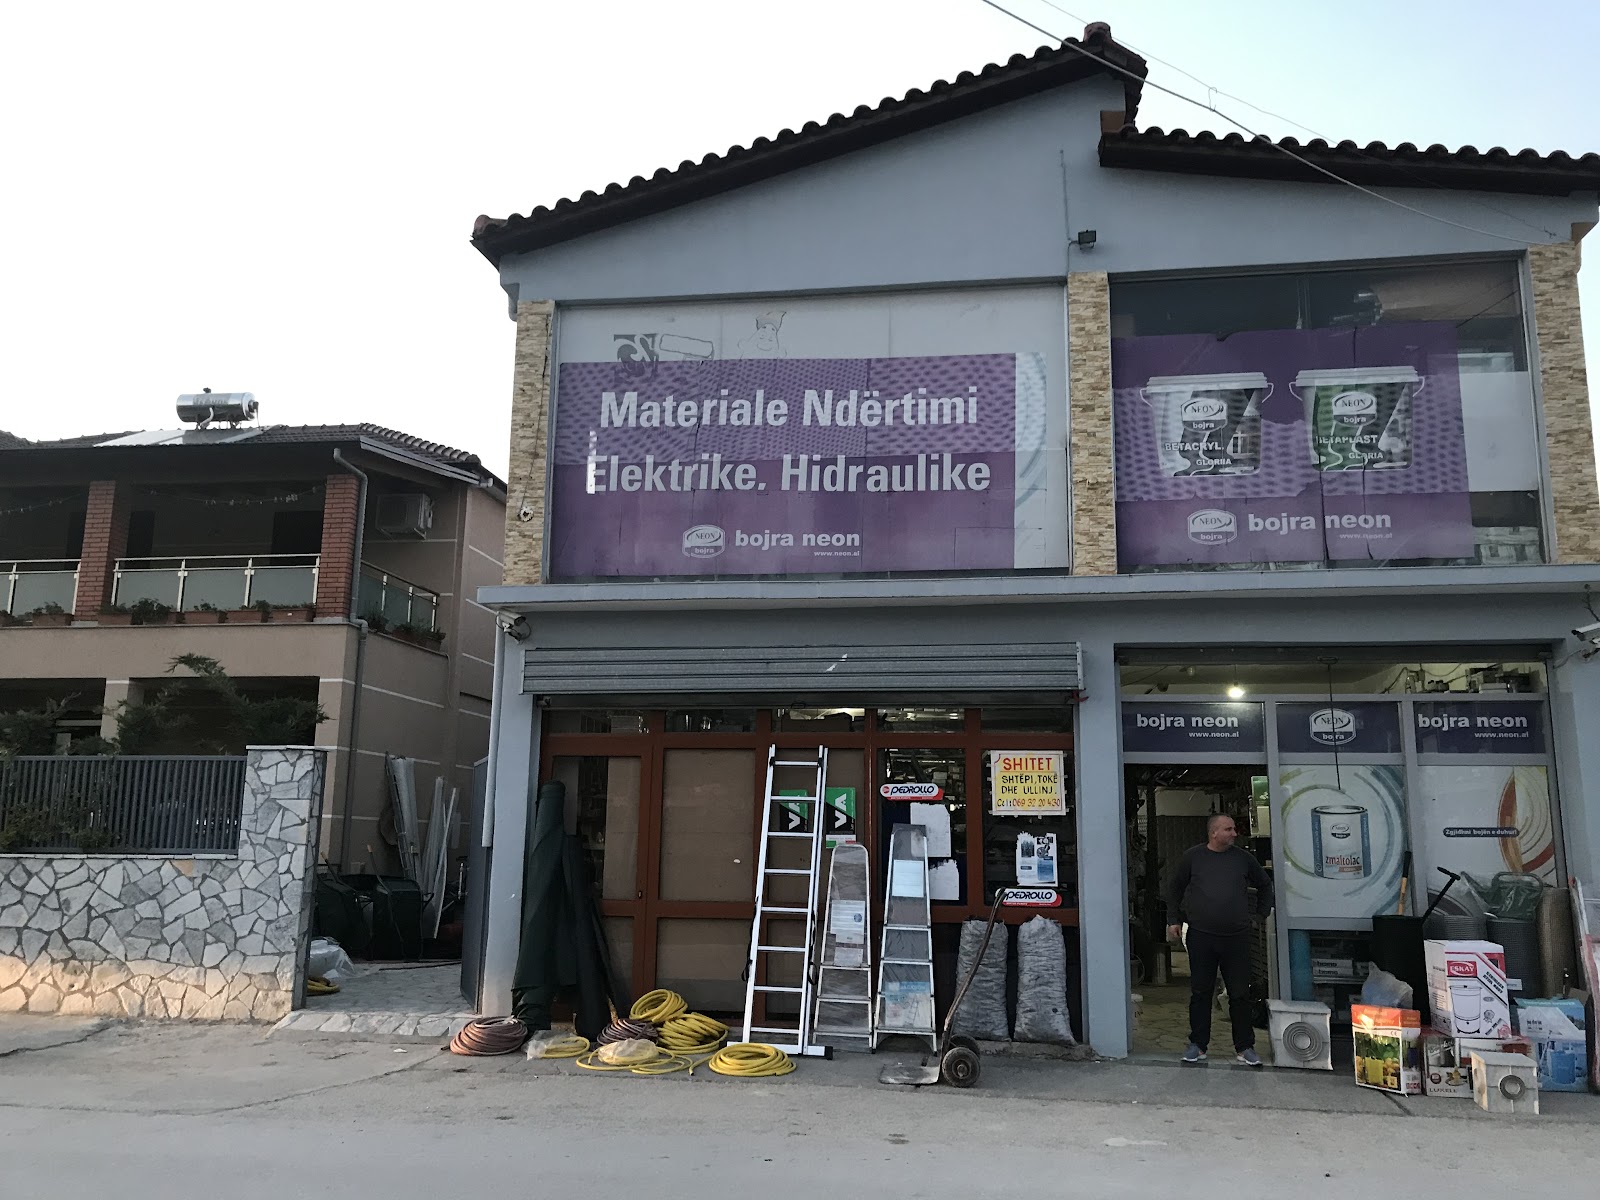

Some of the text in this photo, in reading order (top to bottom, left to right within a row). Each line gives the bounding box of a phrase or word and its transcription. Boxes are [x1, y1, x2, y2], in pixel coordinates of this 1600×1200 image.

[600, 386, 978, 428] Materiale Ndërtimi
[1341, 399, 1366, 407] NEON
[1191, 405, 1214, 413] NEON
[1343, 416, 1366, 424] bojra
[1192, 422, 1215, 430] bojra
[781, 453, 991, 492] Hidraulike
[1199, 517, 1223, 525] NEON
[1248, 513, 1391, 535] bojra neon
[735, 530, 860, 550] bojra neon
[1200, 533, 1223, 541] bojra
[1136, 714, 1239, 730] bojra neon
[1418, 713, 1528, 731] bojra neon
[1002, 757, 1053, 771] SHITET
[890, 785, 935, 795] PEDROLLO
[1001, 786, 1018, 795] DHE
[1006, 891, 1053, 900] PEDROLLO
